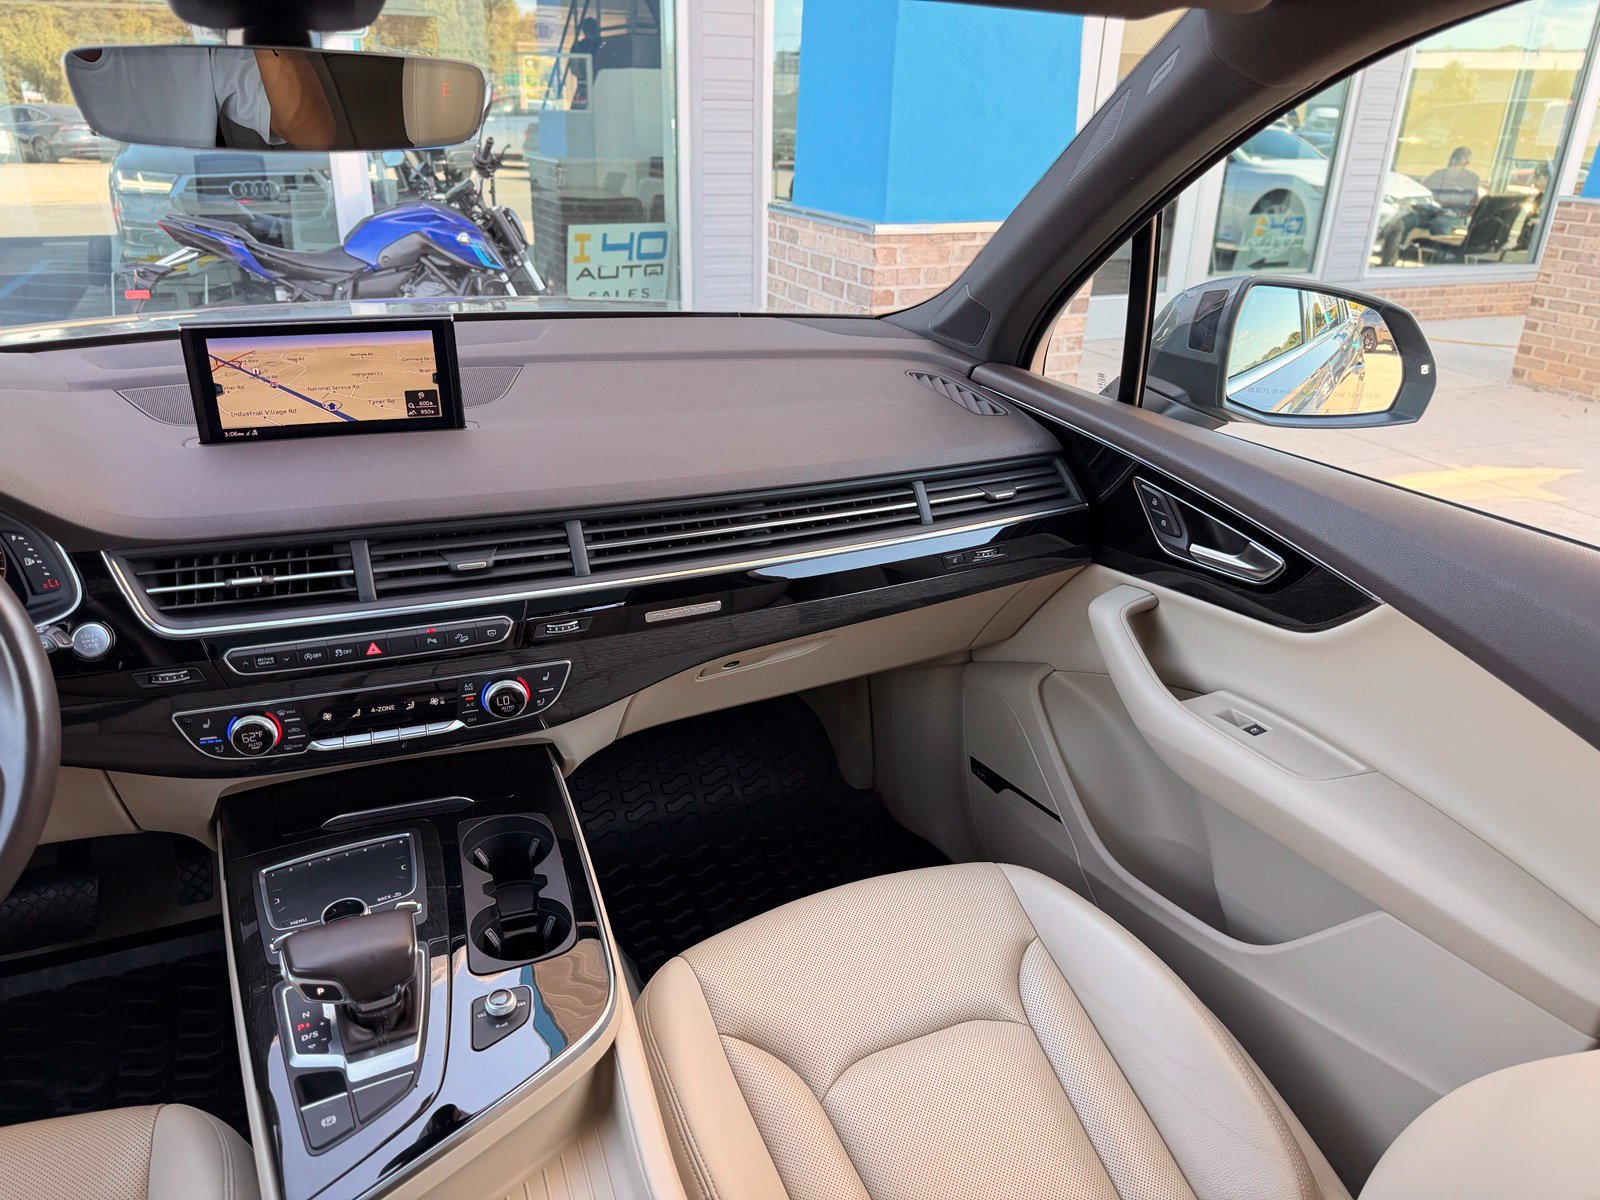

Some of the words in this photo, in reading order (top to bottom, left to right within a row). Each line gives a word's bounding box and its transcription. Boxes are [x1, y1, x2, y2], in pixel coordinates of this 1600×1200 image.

[573, 233, 592, 264] I
[601, 231, 668, 261] 40
[575, 263, 664, 281] AUTO
[11, 534, 17, 542] F
[370, 704, 396, 713] 4-ZONE
[377, 894, 392, 902] BACK
[290, 917, 308, 926] MENU
[316, 987, 325, 996] P
[301, 1010, 311, 1019] N
[301, 1030, 319, 1042] D/S
